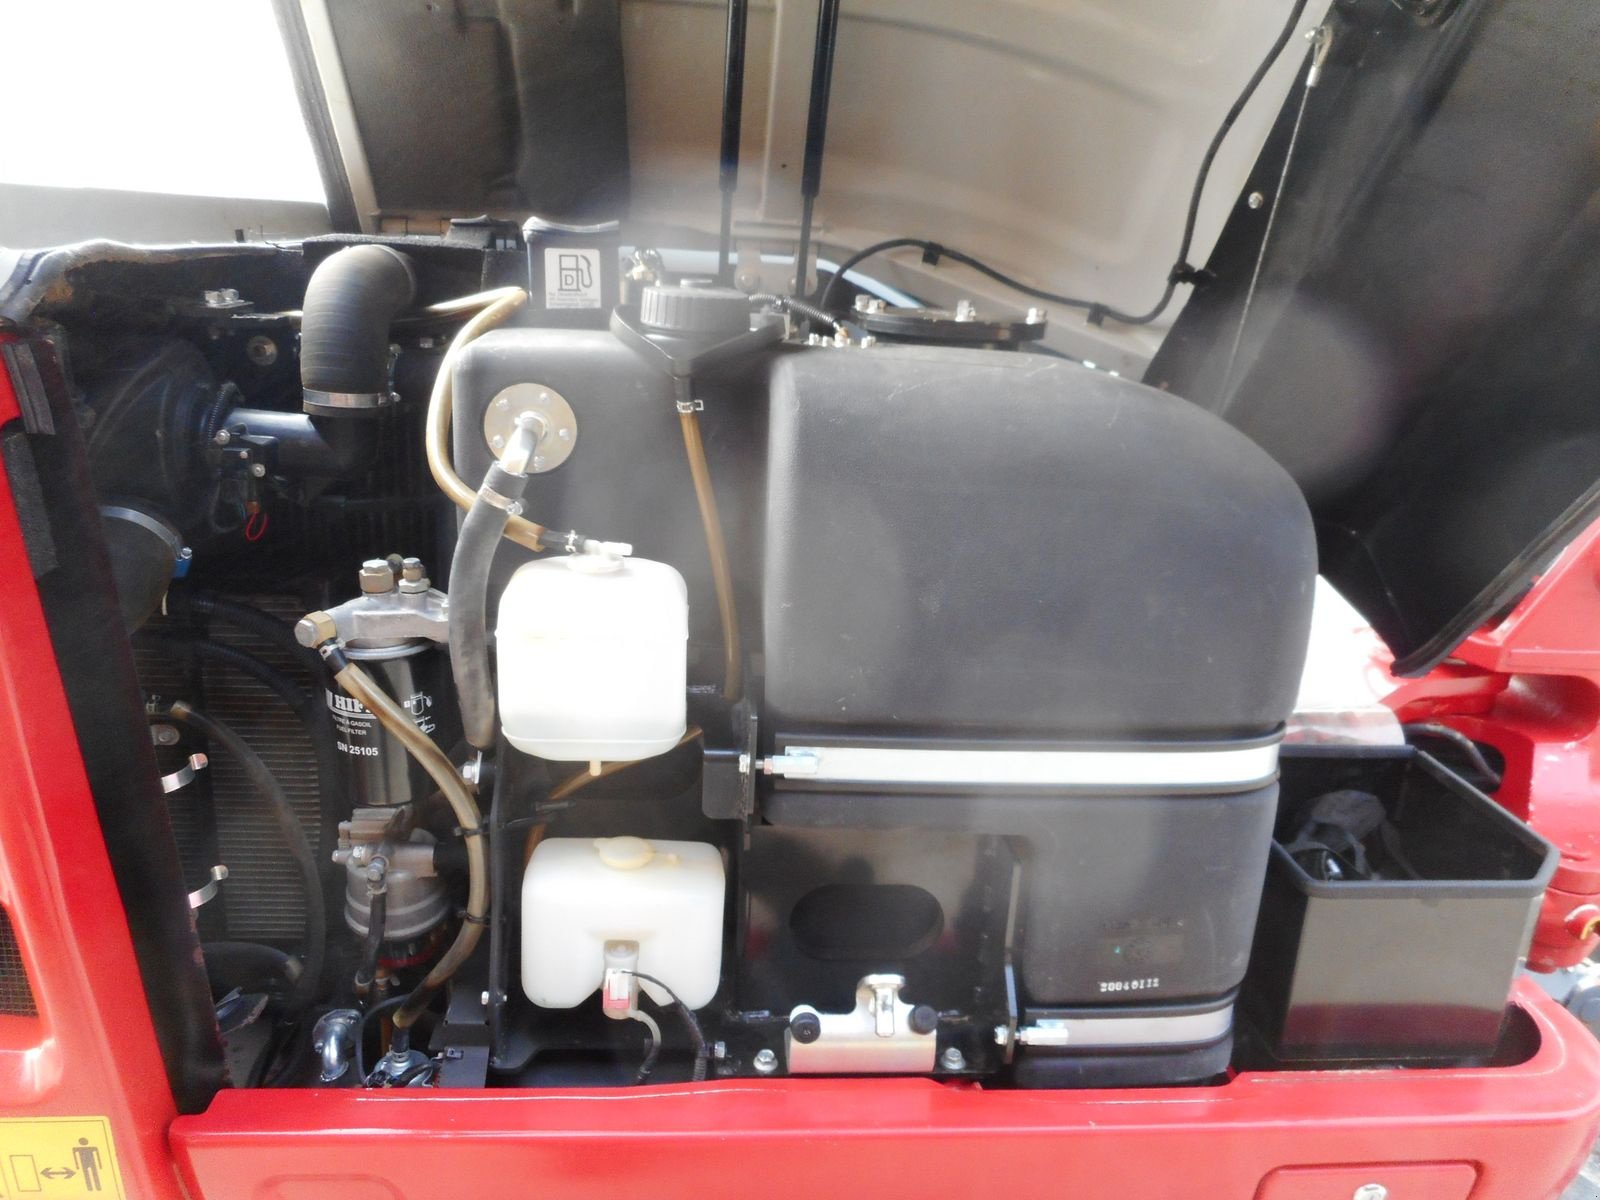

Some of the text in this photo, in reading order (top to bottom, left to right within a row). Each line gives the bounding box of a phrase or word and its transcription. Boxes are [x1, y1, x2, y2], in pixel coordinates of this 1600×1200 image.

[564, 274, 574, 286] D
[334, 694, 371, 713] HIF
[350, 720, 372, 728] GASOIL
[347, 727, 367, 736] FILTER
[337, 741, 379, 756] SN 25105
